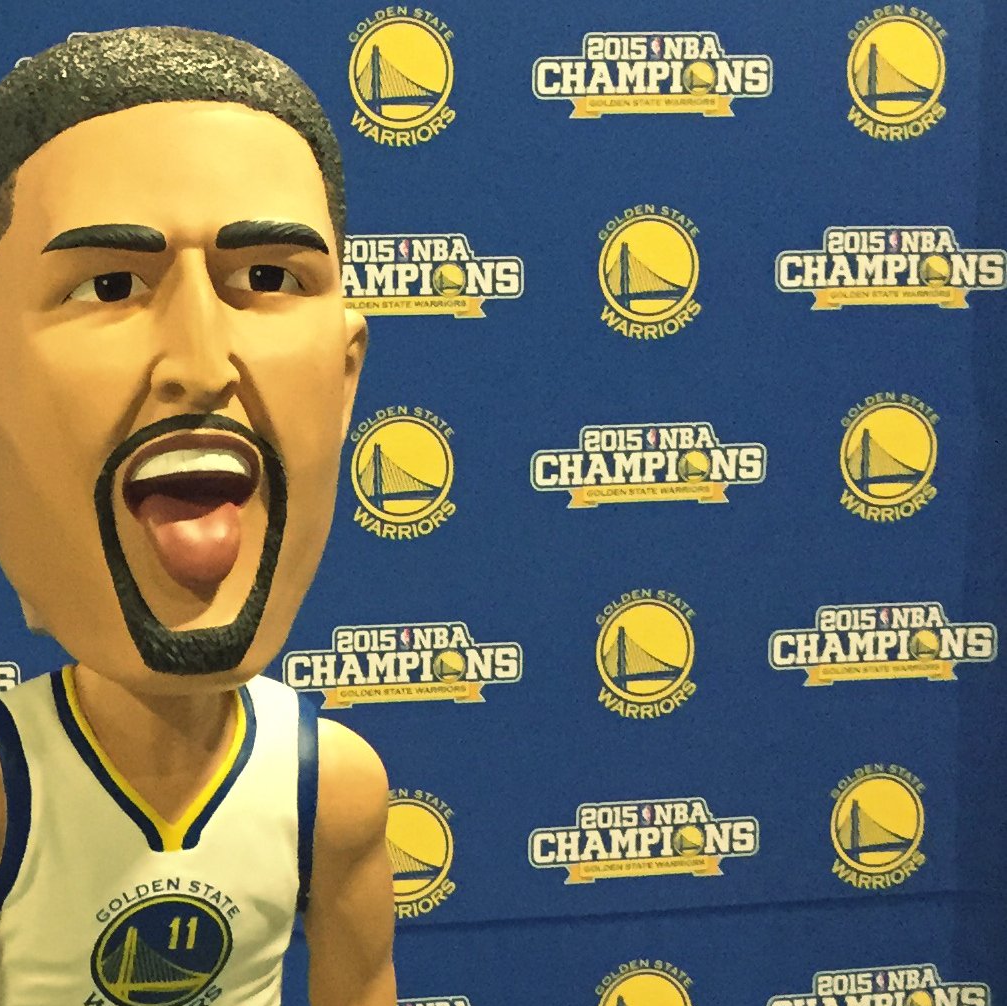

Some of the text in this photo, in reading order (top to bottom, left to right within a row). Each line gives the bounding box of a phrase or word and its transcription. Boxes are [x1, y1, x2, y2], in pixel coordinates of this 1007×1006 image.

[348, 6, 455, 43] GOLDEN STATE
[587, 37, 719, 60] 2015 NBA
[536, 60, 767, 94] CHAMPIONS
[351, 106, 456, 147] WARRIORS
[598, 204, 700, 240] GOLDEN STATE
[412, 239, 469, 262] NBA
[828, 232, 954, 253] 2015 NBA
[779, 254, 1000, 287] CHAMPIONS
[601, 300, 701, 339] WARRIORS
[351, 405, 454, 442] GOLDEN STATE
[584, 427, 714, 452] 2015 NBA
[534, 448, 761, 486] CHAMPIONS
[354, 500, 456, 539] WARRIORS
[596, 589, 696, 625] GOLDEN STATE
[820, 607, 943, 632] 2015 NBA
[337, 627, 469, 653] 2015 NBA
[772, 627, 988, 665] CHAMPIONS
[286, 647, 517, 687] CHAMPIONS
[598, 680, 696, 719] WARRIORS
[414, 790, 454, 819] STATE
[581, 802, 707, 829] 2015 NBA
[532, 821, 754, 863] CHAMPIONS
[95, 877, 241, 924] GOLDEN STATE
[167, 916, 198, 950] 11
[817, 968, 938, 996] 2015 NBA
